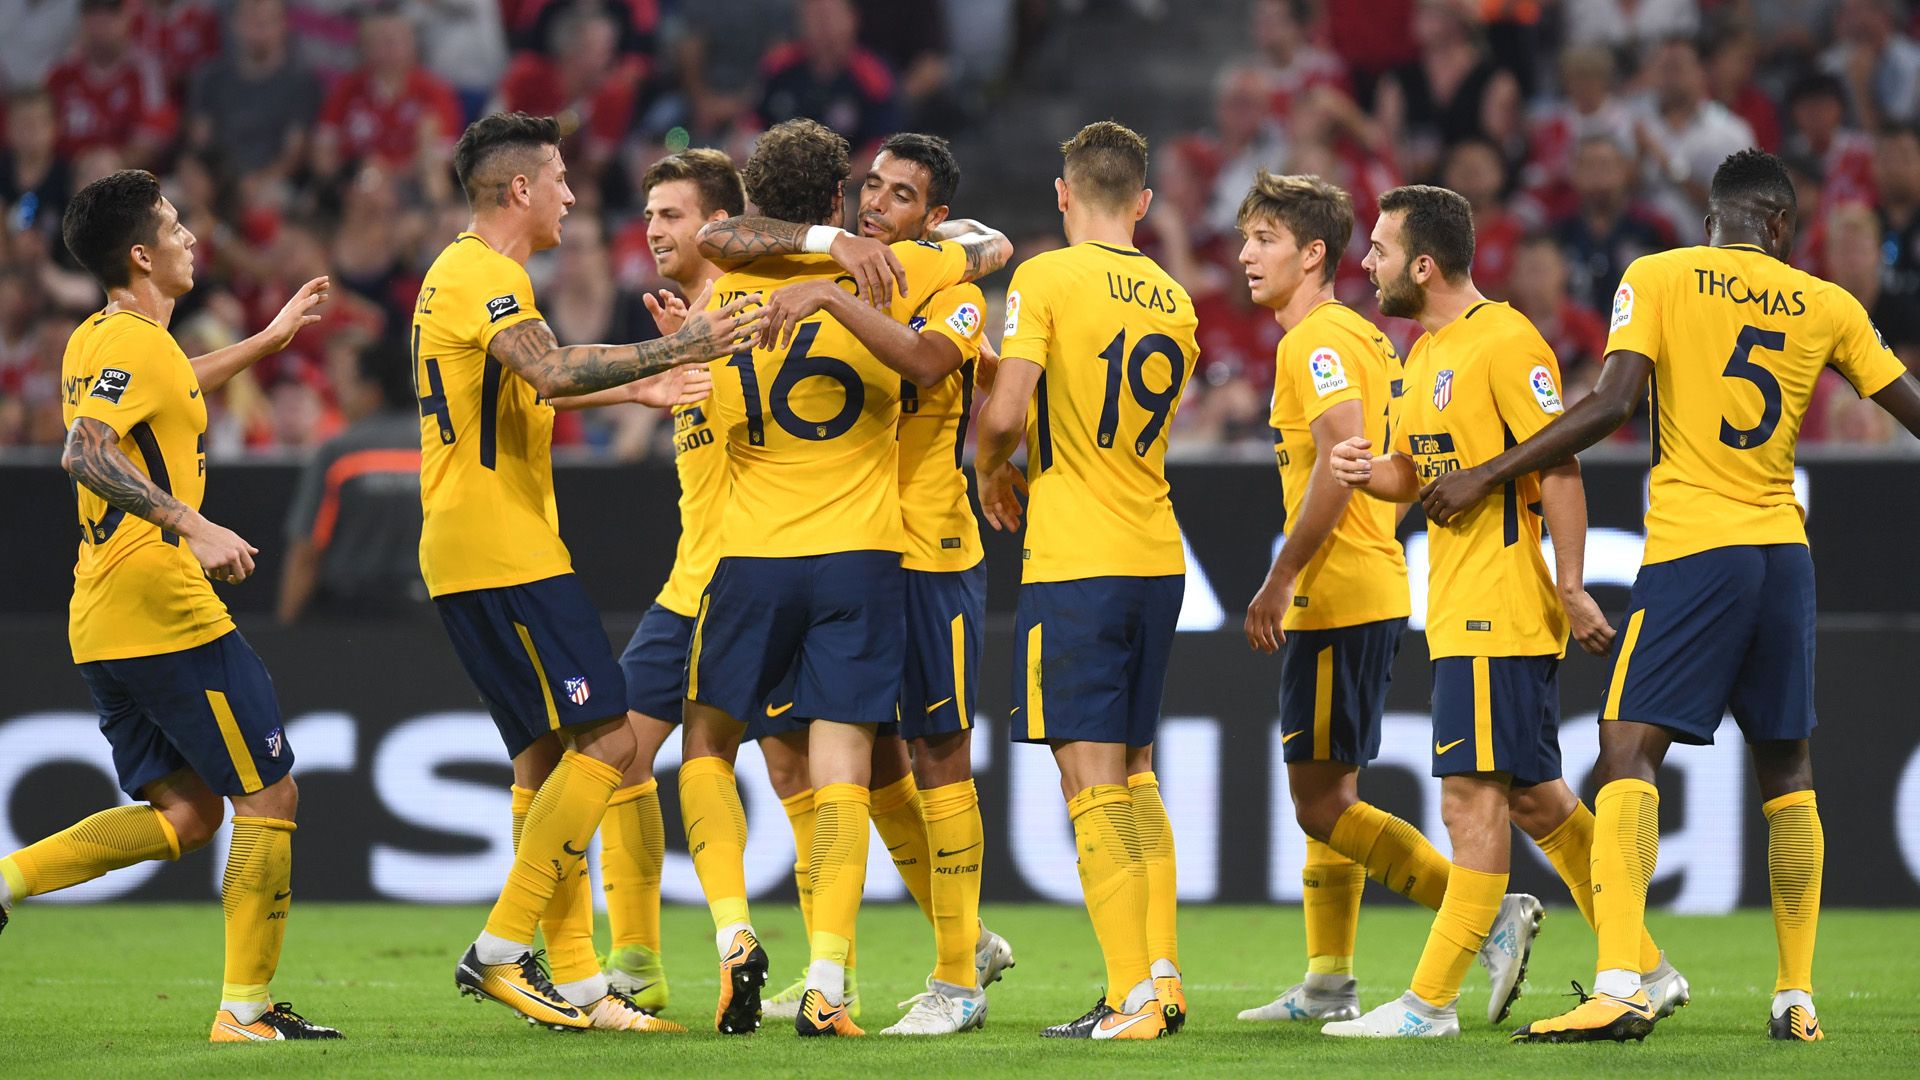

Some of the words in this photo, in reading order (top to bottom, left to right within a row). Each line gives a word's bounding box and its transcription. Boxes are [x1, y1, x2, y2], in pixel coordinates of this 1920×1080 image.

[1107, 271, 1176, 314] LUCAS
[1695, 268, 1806, 317] THOMAS
[726, 321, 865, 447] 16
[1097, 326, 1185, 458] 19
[1317, 378, 1344, 391] LaLiga
[1719, 324, 1786, 450] 5
[935, 863, 979, 875] ATLÉTICO
